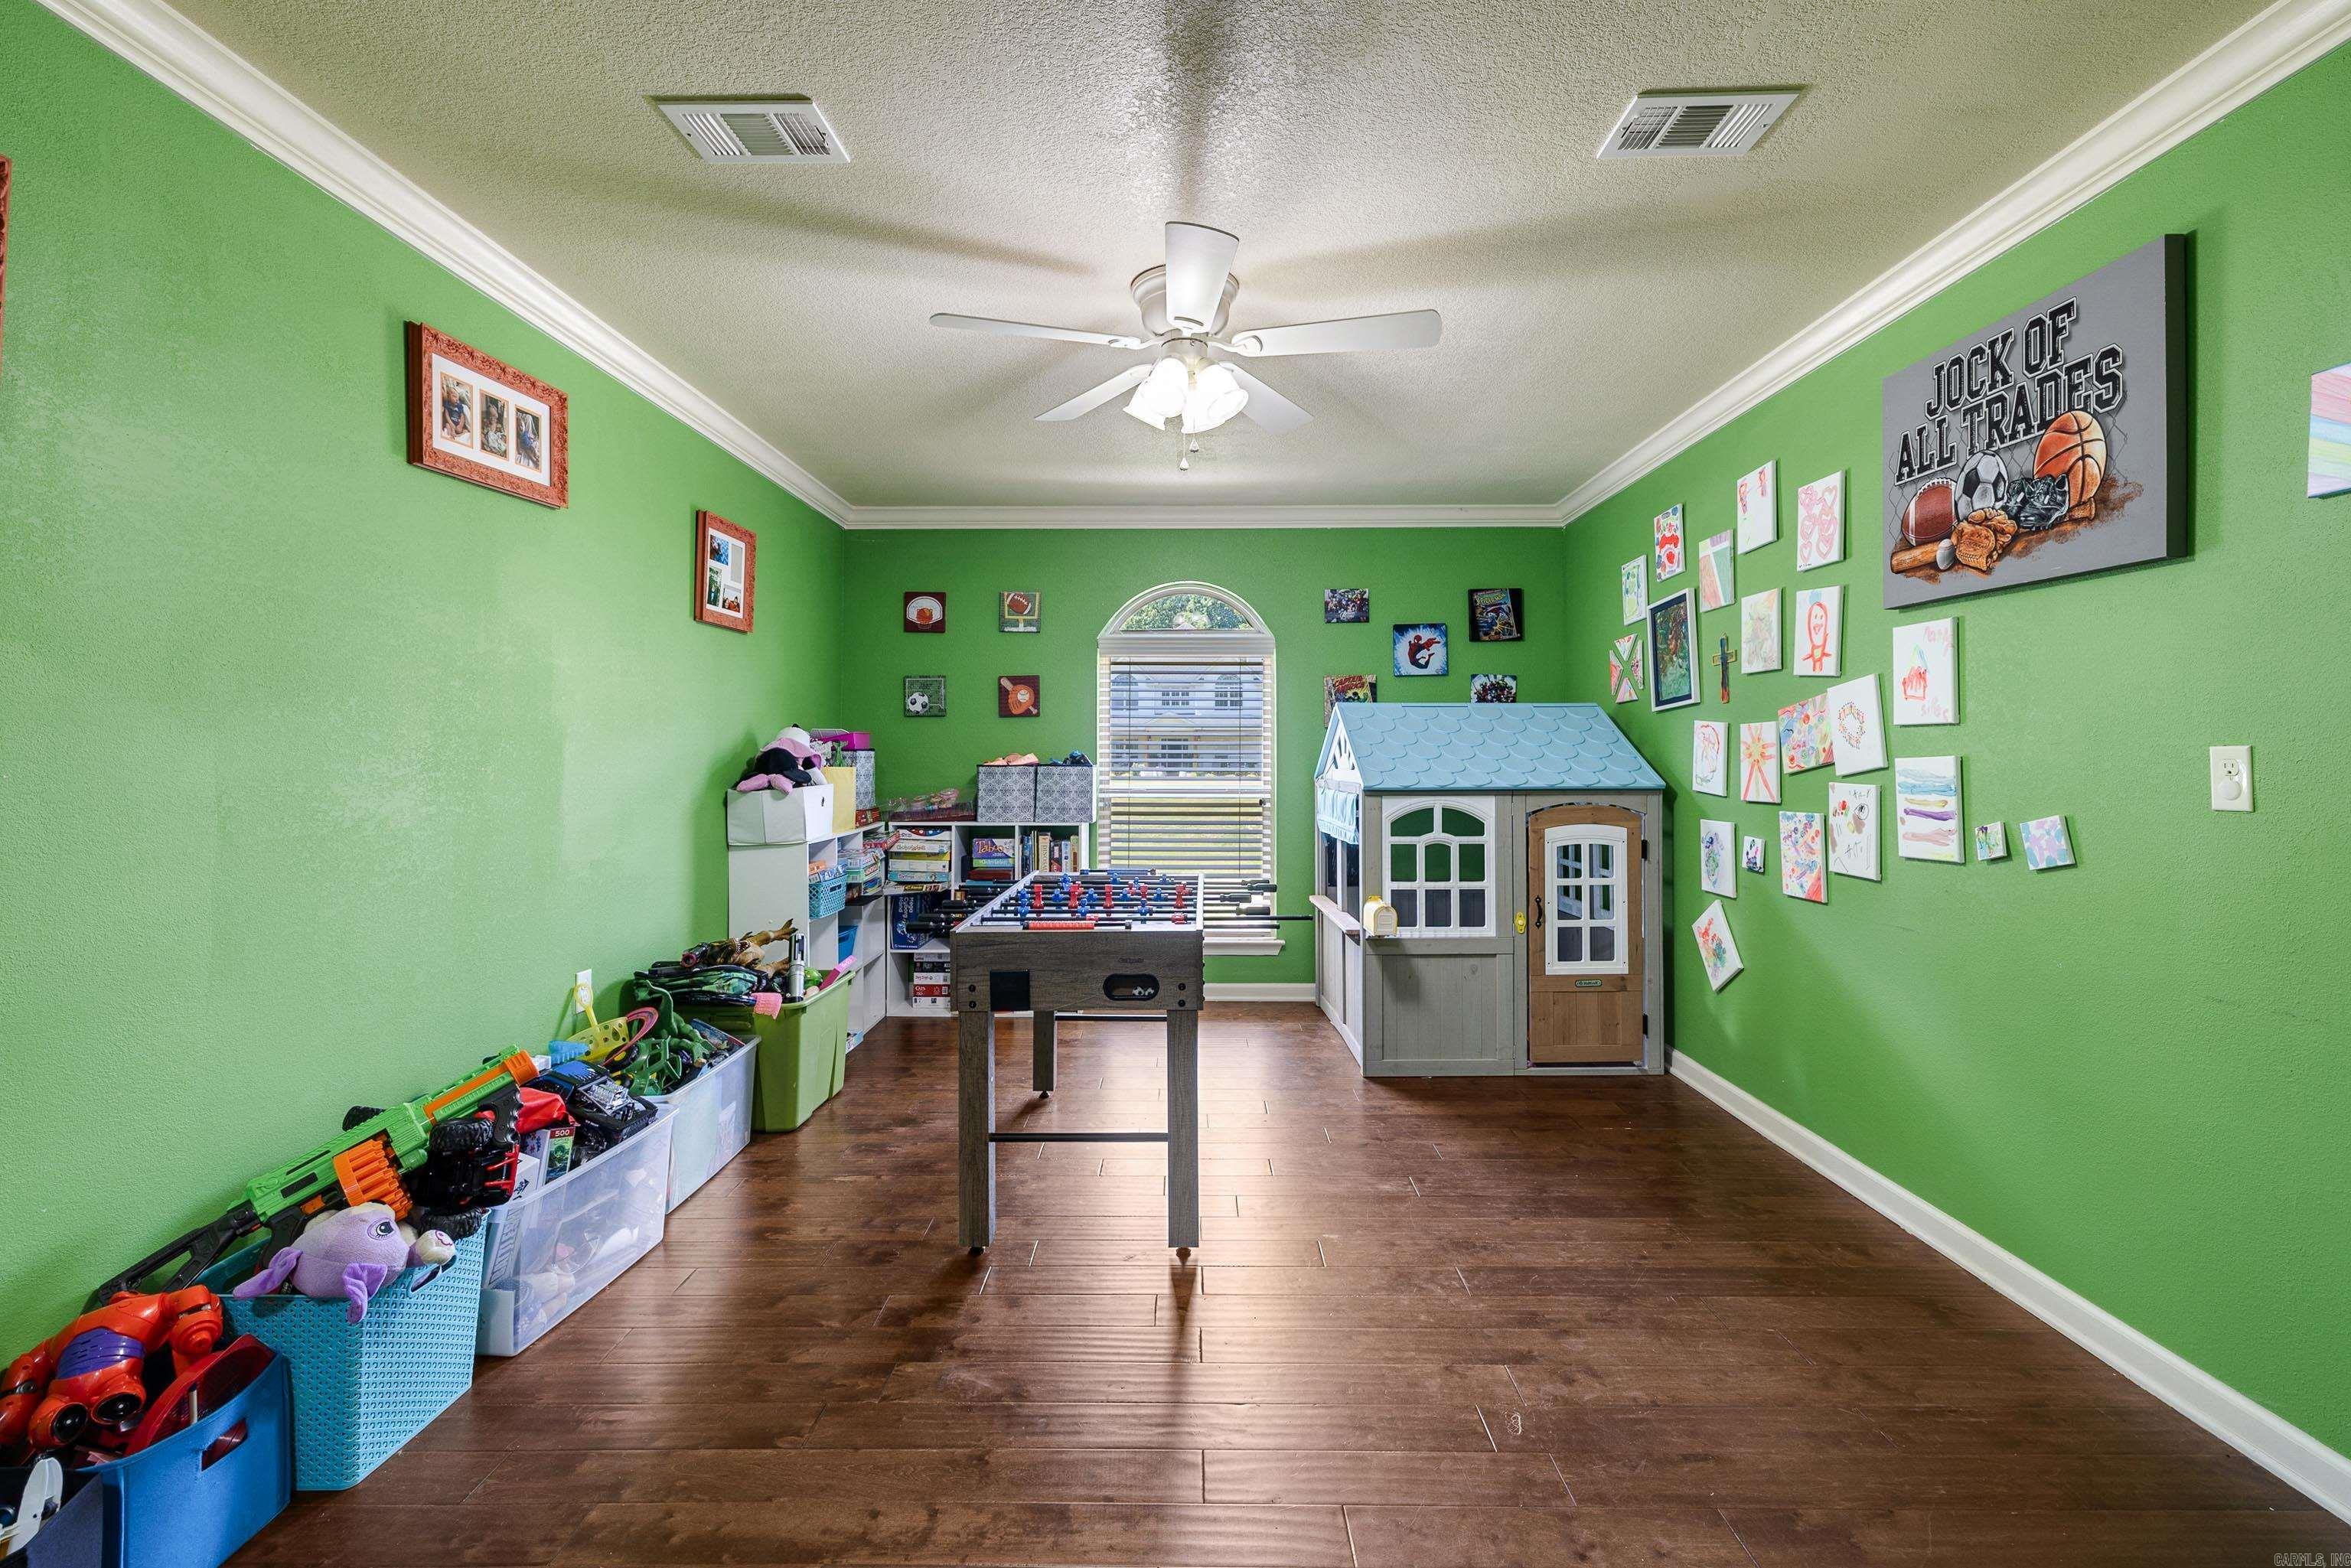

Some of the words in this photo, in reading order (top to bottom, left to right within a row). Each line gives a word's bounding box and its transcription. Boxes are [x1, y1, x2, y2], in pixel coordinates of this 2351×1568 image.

[1894, 414, 1958, 486] ALL
[1961, 343, 2124, 459] TRADES
[1925, 327, 2015, 421] JOCK
[2022, 296, 2078, 378] OF
[975, 840, 1004, 854] Taboo
